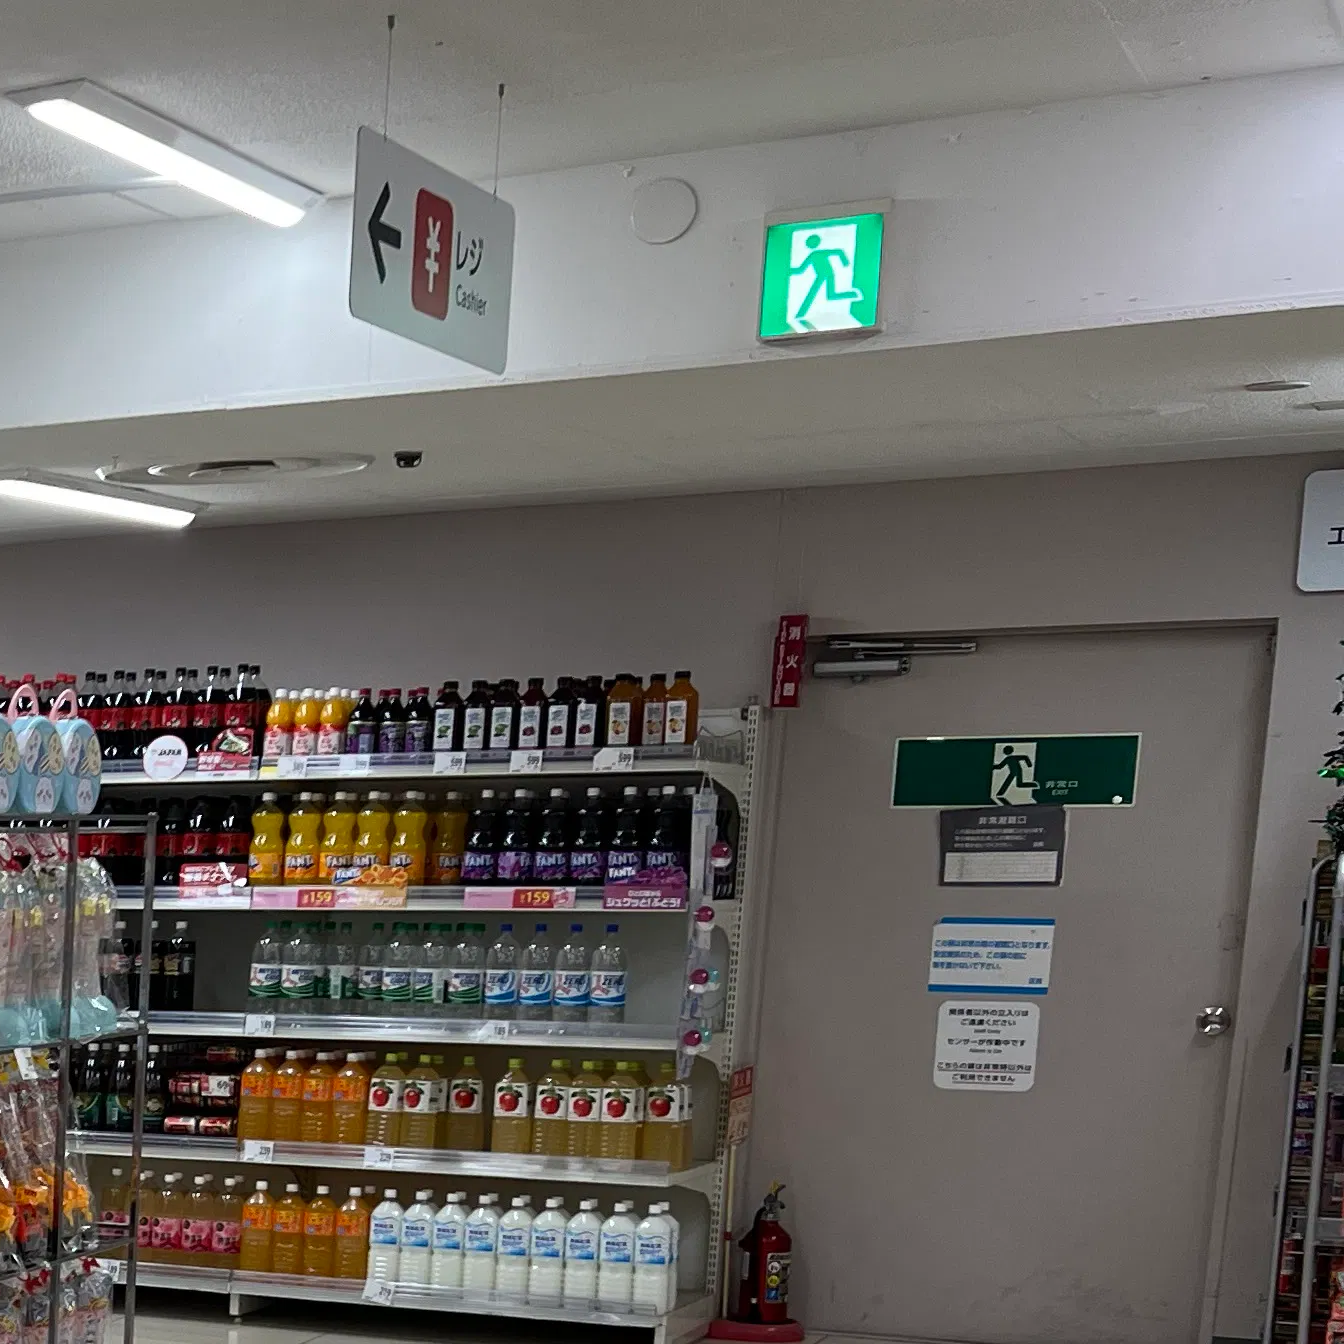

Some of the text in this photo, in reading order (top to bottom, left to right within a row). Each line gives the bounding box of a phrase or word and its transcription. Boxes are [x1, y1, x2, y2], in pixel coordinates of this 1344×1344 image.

[456, 231, 484, 276] レジ
[455, 284, 487, 316] Cashier
[1045, 780, 1079, 789] 非常口
